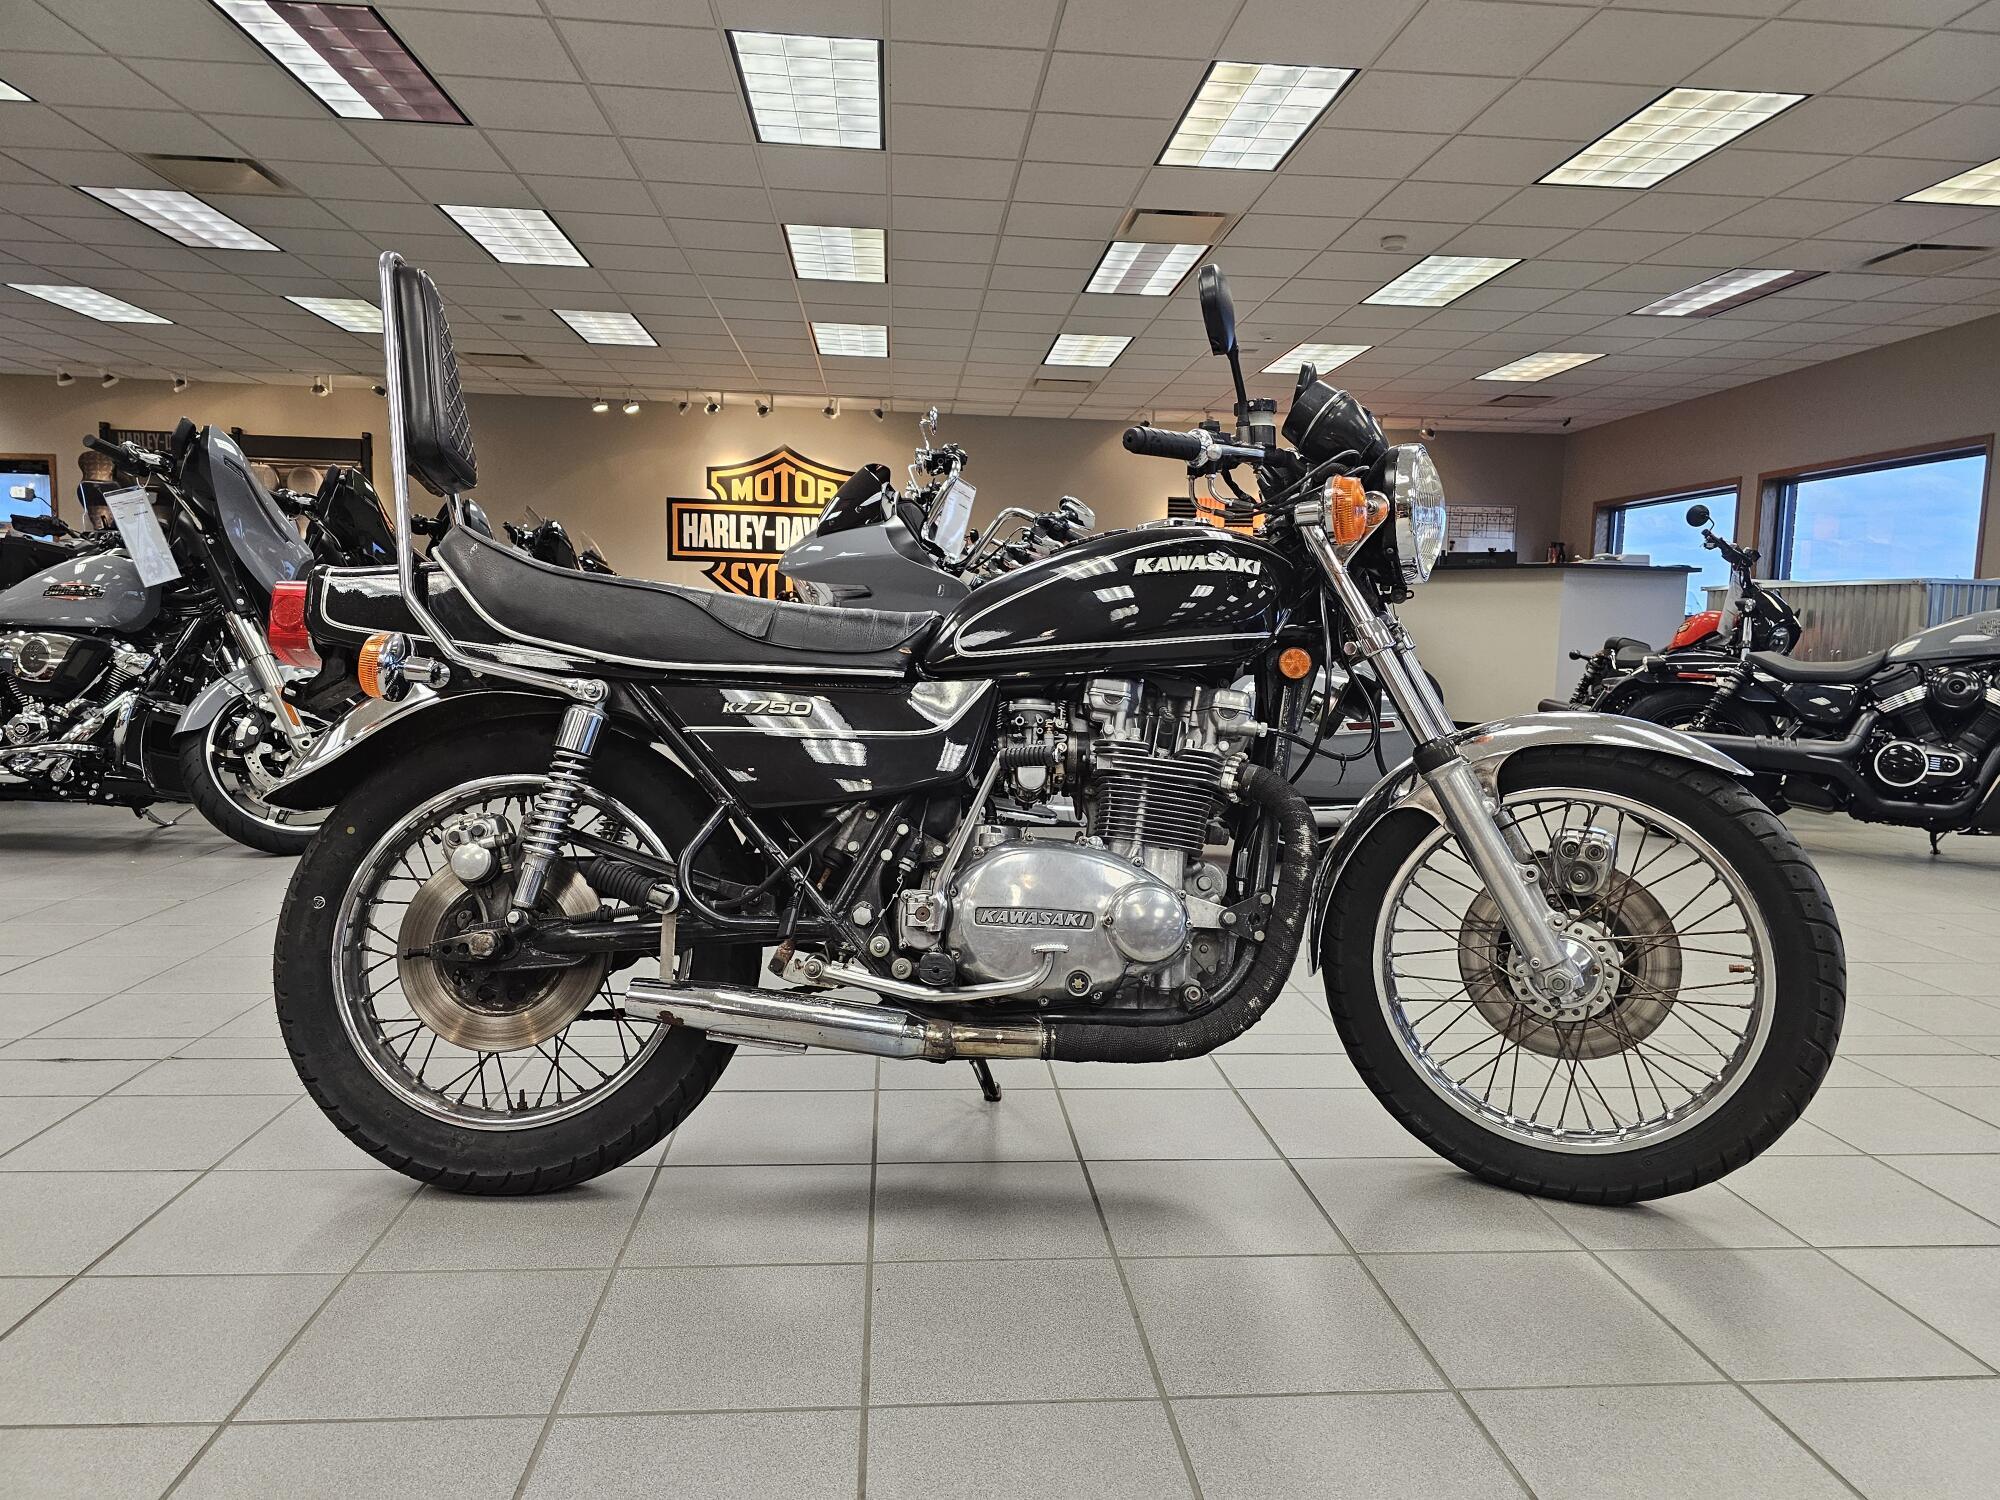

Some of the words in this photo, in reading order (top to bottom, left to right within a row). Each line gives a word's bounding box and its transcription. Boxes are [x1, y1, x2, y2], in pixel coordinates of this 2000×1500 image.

[731, 462, 838, 505] MOTOR
[1133, 553, 1261, 576] KAWASAKI
[980, 909, 1088, 928] KAWASAKI
